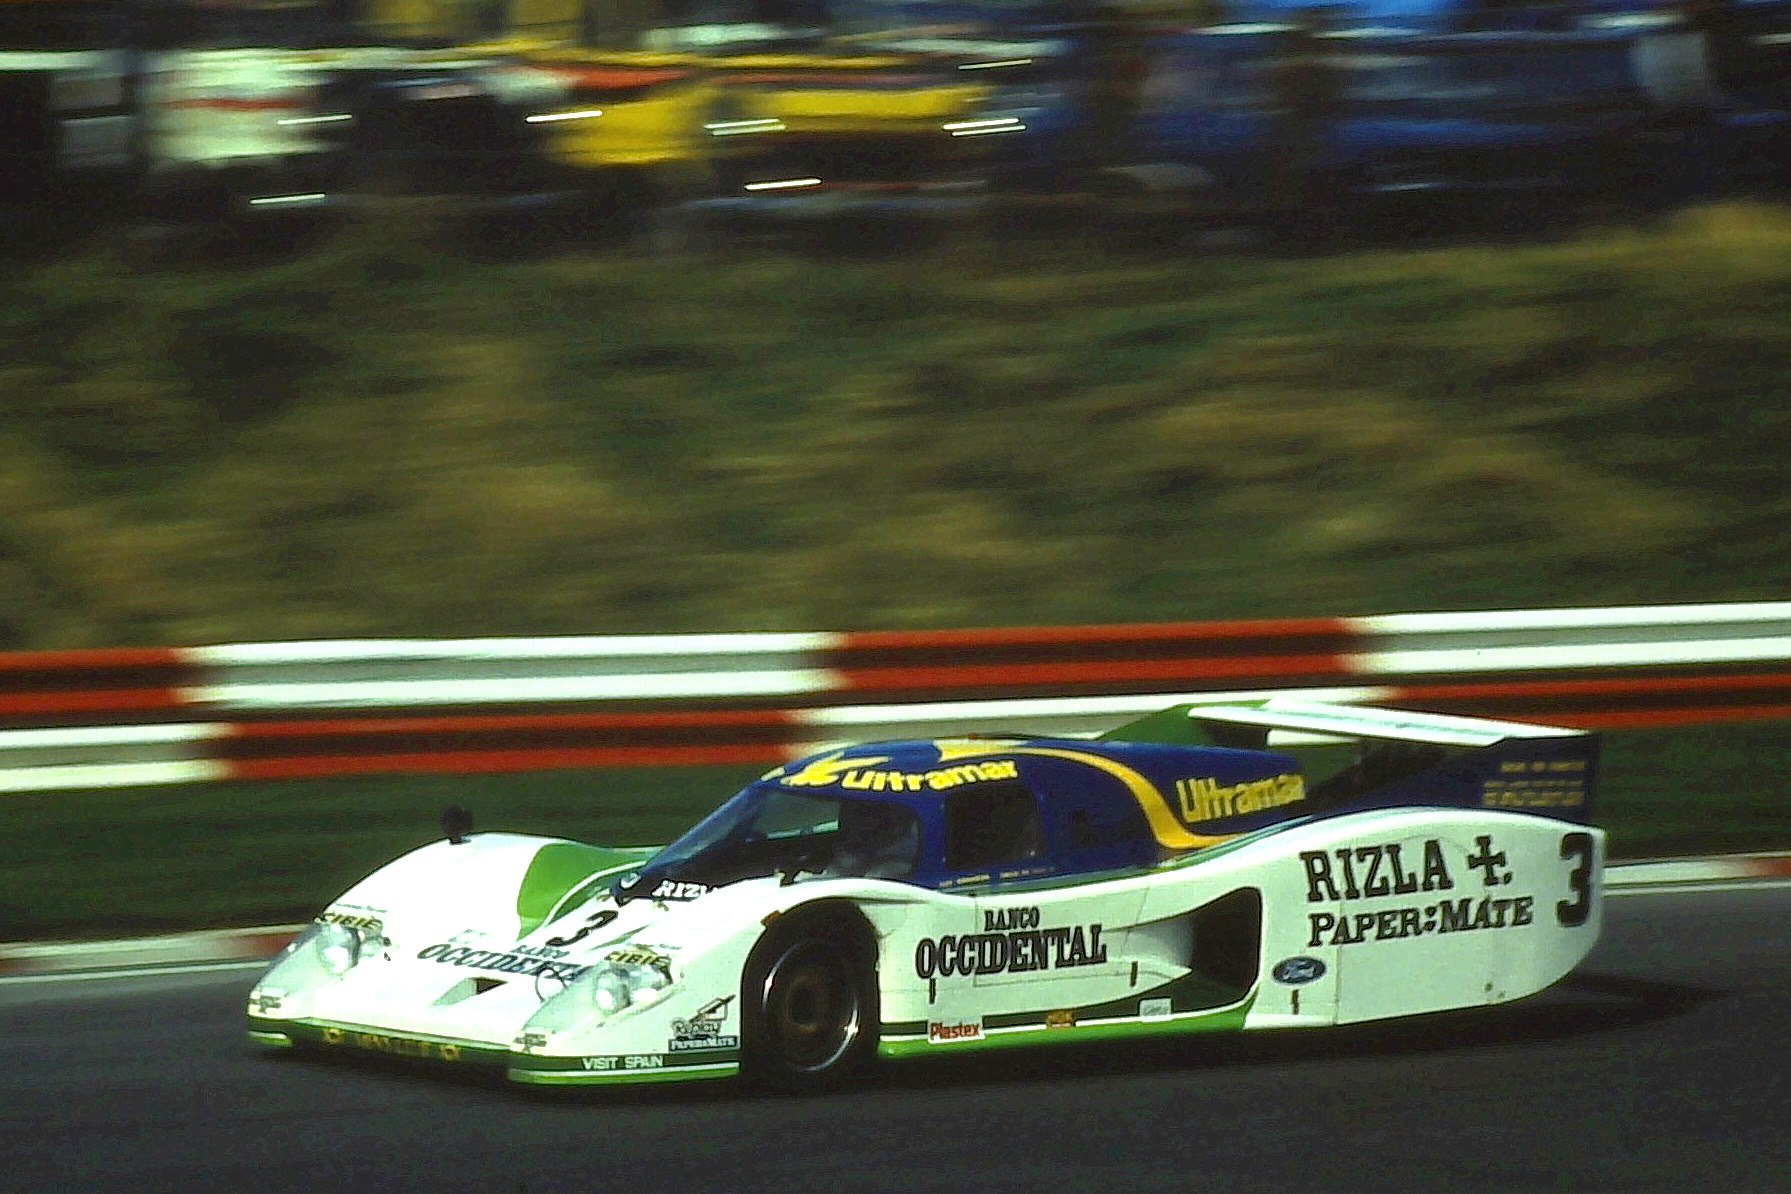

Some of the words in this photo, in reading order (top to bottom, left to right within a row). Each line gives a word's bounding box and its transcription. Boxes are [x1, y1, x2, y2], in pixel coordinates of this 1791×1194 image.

[1300, 839, 1454, 903] RIZLA
[1556, 832, 1595, 928] 3
[545, 910, 618, 946] 3
[984, 906, 1040, 932] BANCO
[915, 924, 1107, 979] OCCIDENTAL
[582, 1058, 619, 1070] VISIT
[625, 1055, 664, 1068] SPAIN
